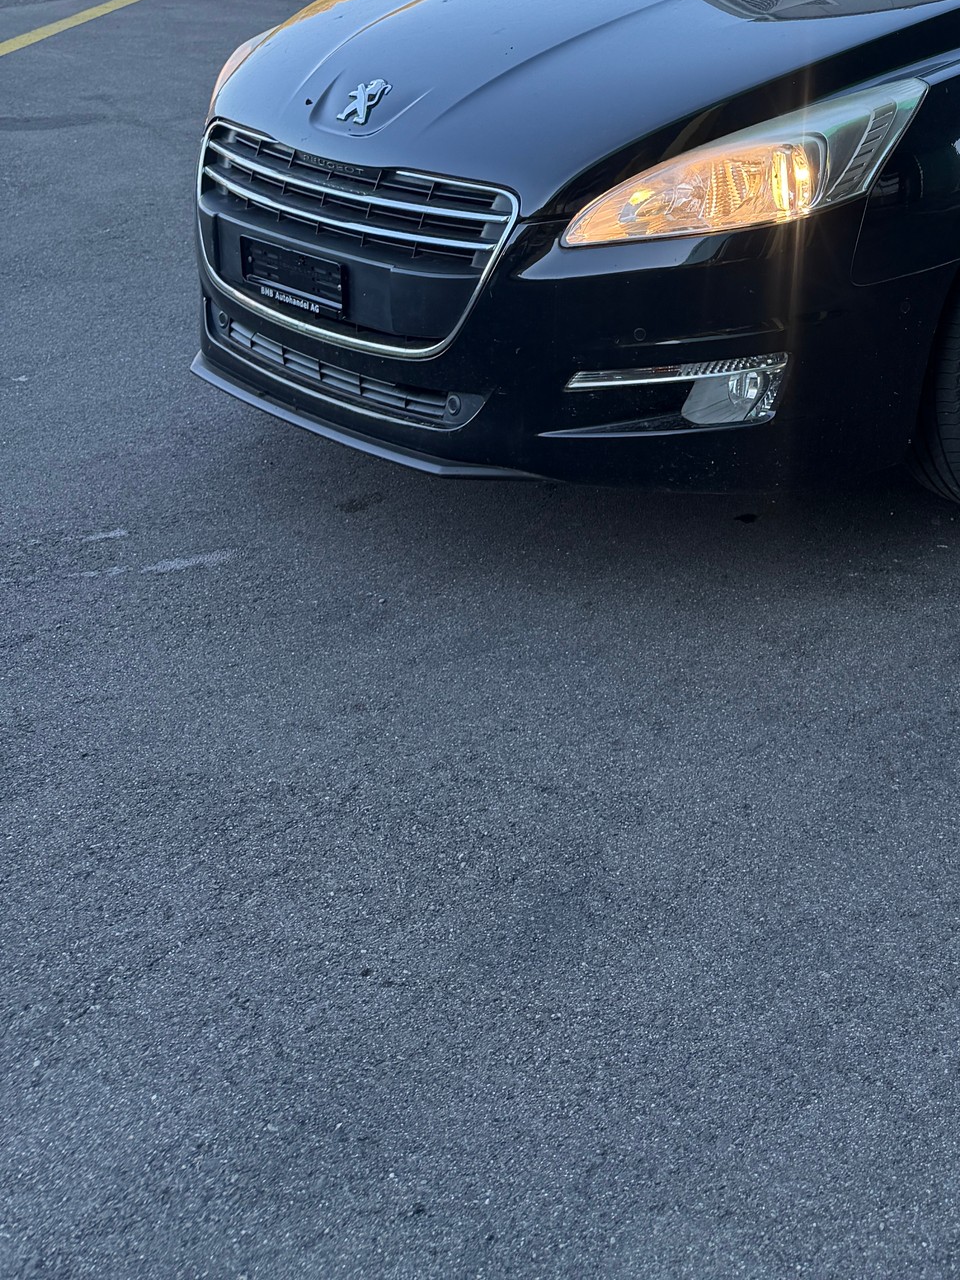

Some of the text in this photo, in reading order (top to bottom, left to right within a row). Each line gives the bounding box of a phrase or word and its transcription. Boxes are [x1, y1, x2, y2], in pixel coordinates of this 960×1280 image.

[303, 154, 365, 175] PEUGEOT
[260, 286, 320, 313] BMB Autohandel AG
